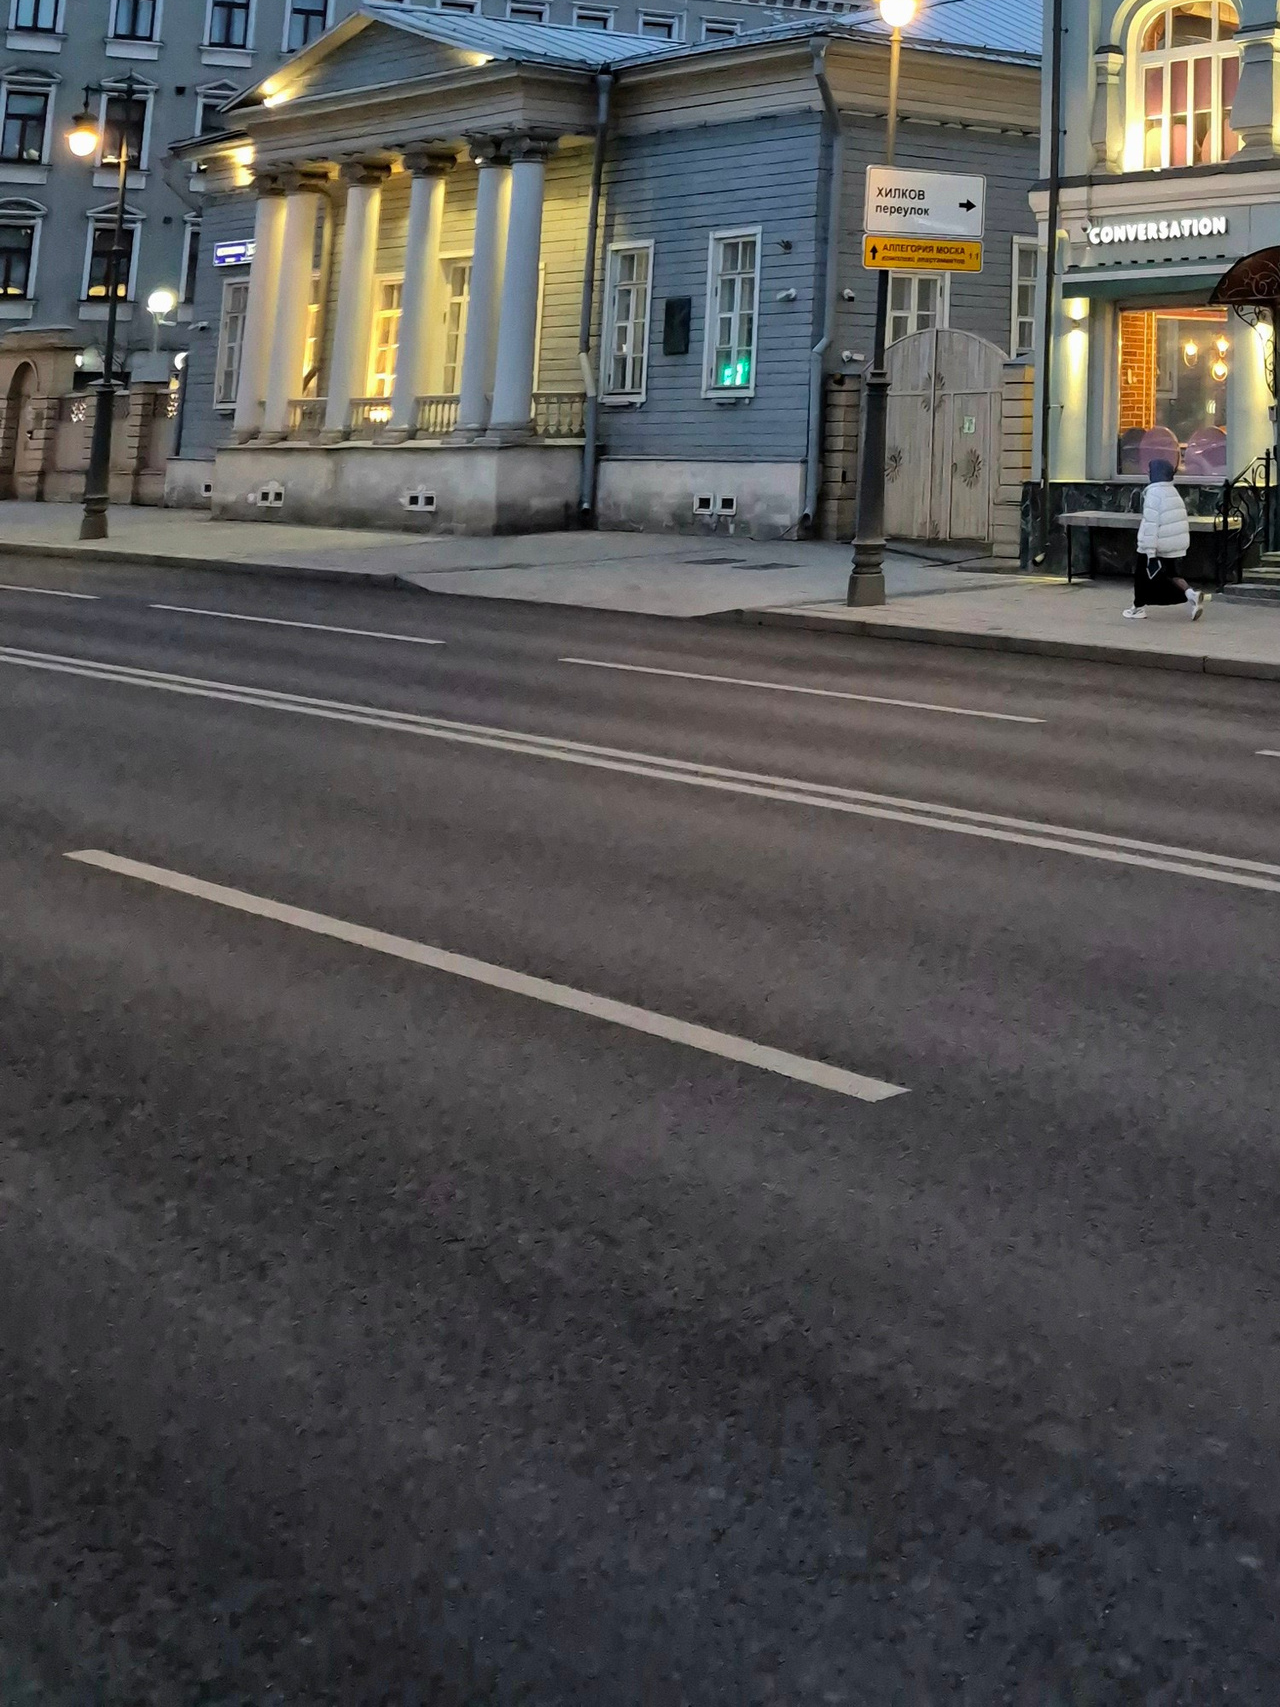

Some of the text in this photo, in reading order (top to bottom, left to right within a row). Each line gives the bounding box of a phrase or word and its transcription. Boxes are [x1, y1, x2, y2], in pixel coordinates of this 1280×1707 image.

[876, 187, 925, 200] ХИЛКОВ
[875, 205, 930, 217] переулок
[1088, 216, 1226, 245] CONVERSATION
[882, 243, 935, 254] АЛЛЕГОРИЯ
